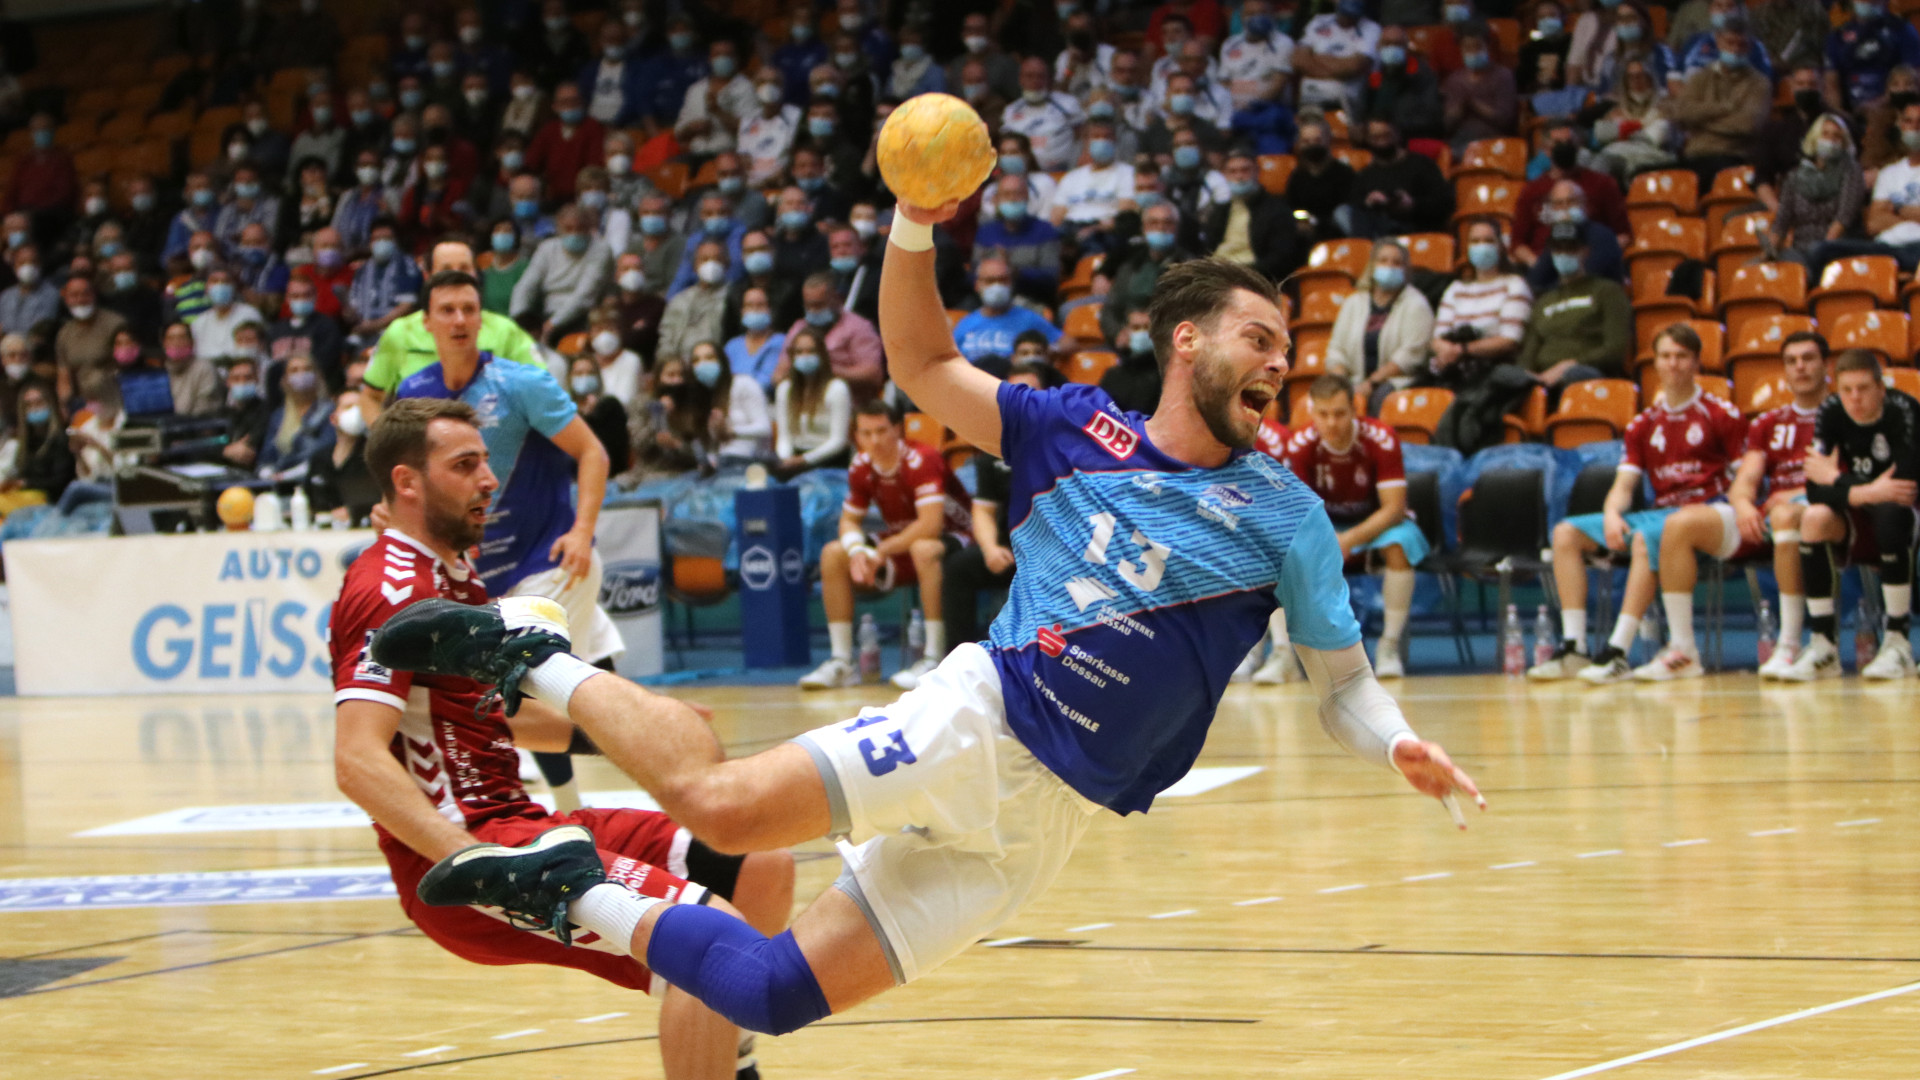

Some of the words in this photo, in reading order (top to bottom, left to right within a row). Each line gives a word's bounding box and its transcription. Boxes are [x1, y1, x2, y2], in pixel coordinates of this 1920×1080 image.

[1092, 415, 1133, 453] DB
[1650, 424, 1666, 453] 4
[1769, 424, 1797, 450] 31
[218, 549, 322, 581] AUTO
[1084, 511, 1172, 592] 13
[602, 570, 659, 611] Ford
[1096, 613, 1132, 636] DESSAU
[1101, 605, 1156, 640] STADTWERKE
[1061, 655, 1107, 688] Dessau
[1069, 645, 1130, 685] Sparkasse
